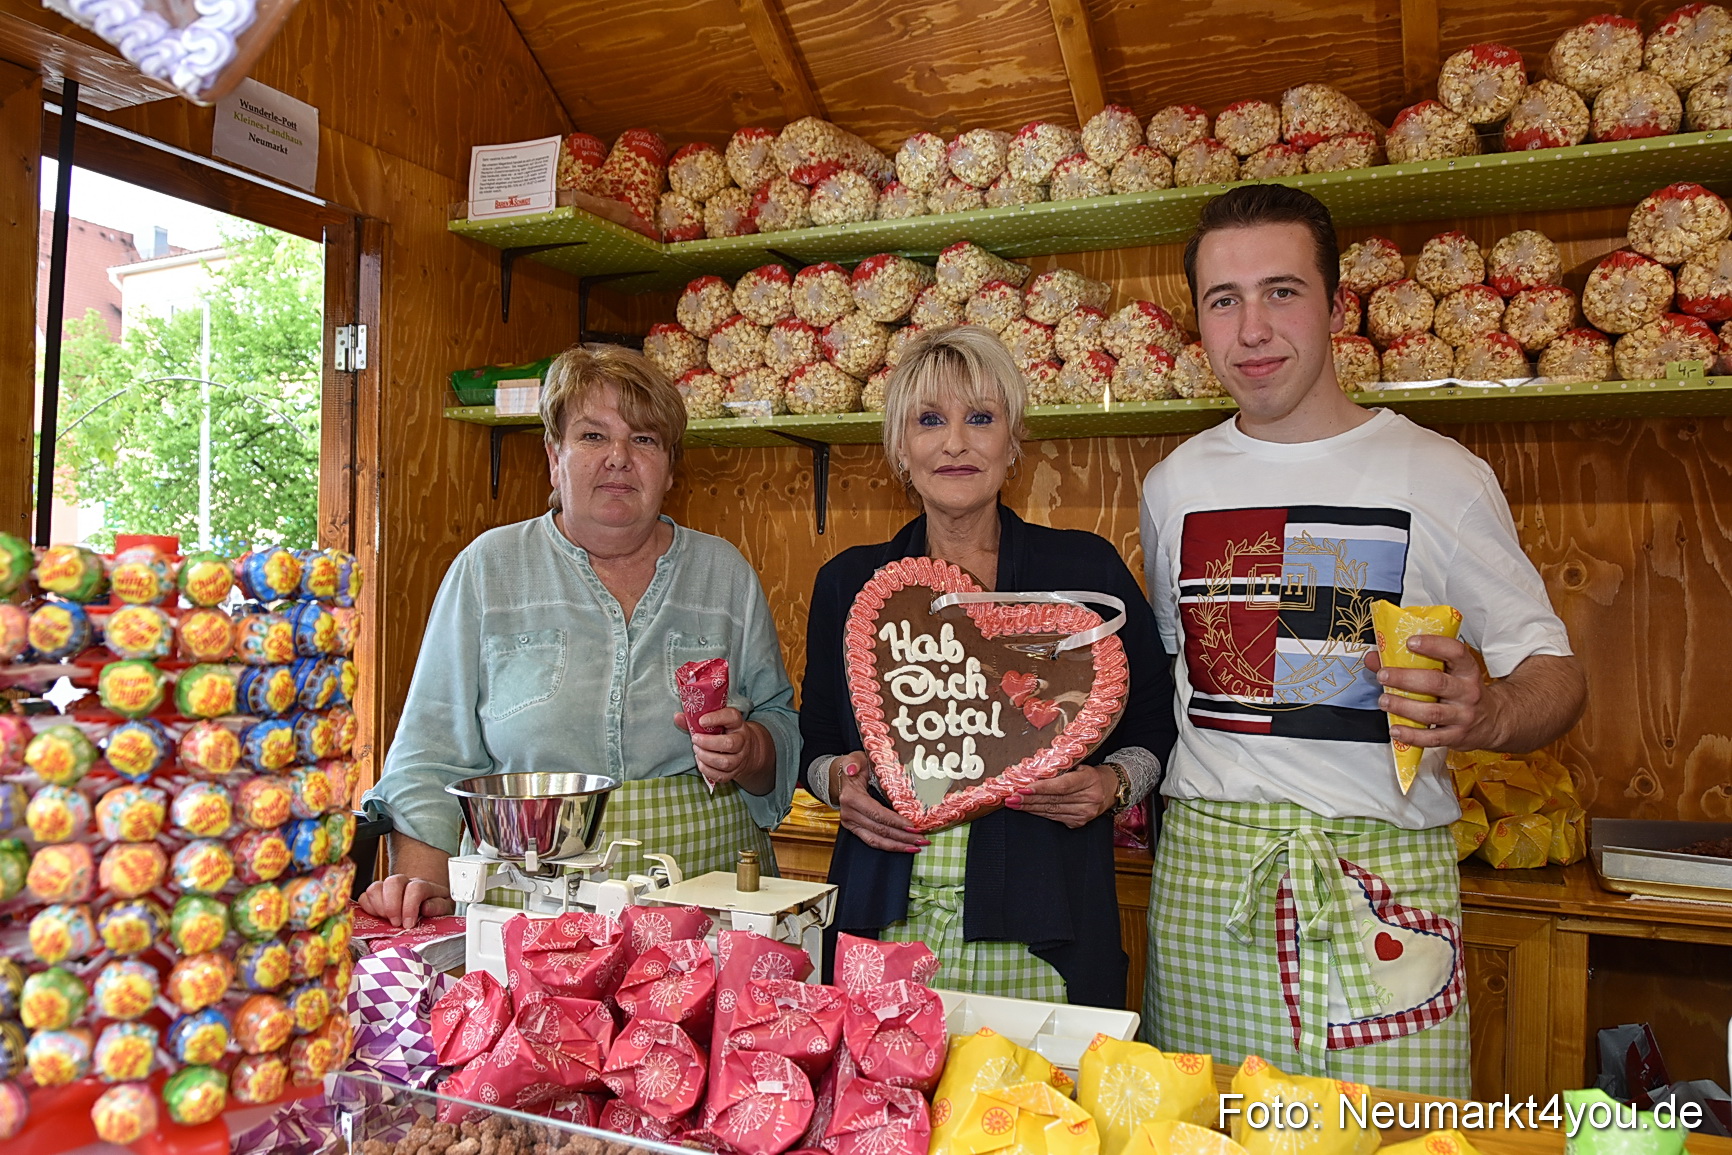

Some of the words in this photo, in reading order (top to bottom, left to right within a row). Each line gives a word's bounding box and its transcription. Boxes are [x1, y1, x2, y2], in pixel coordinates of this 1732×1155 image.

[233, 111, 303, 146] Kleines-Landhaus
[239, 98, 297, 129] Wunderle-Pott
[248, 132, 288, 155] Neumarkt
[879, 619, 965, 663] Hab
[884, 657, 989, 705] Dich
[891, 700, 1006, 742] total
[913, 736, 985, 780] lieb
